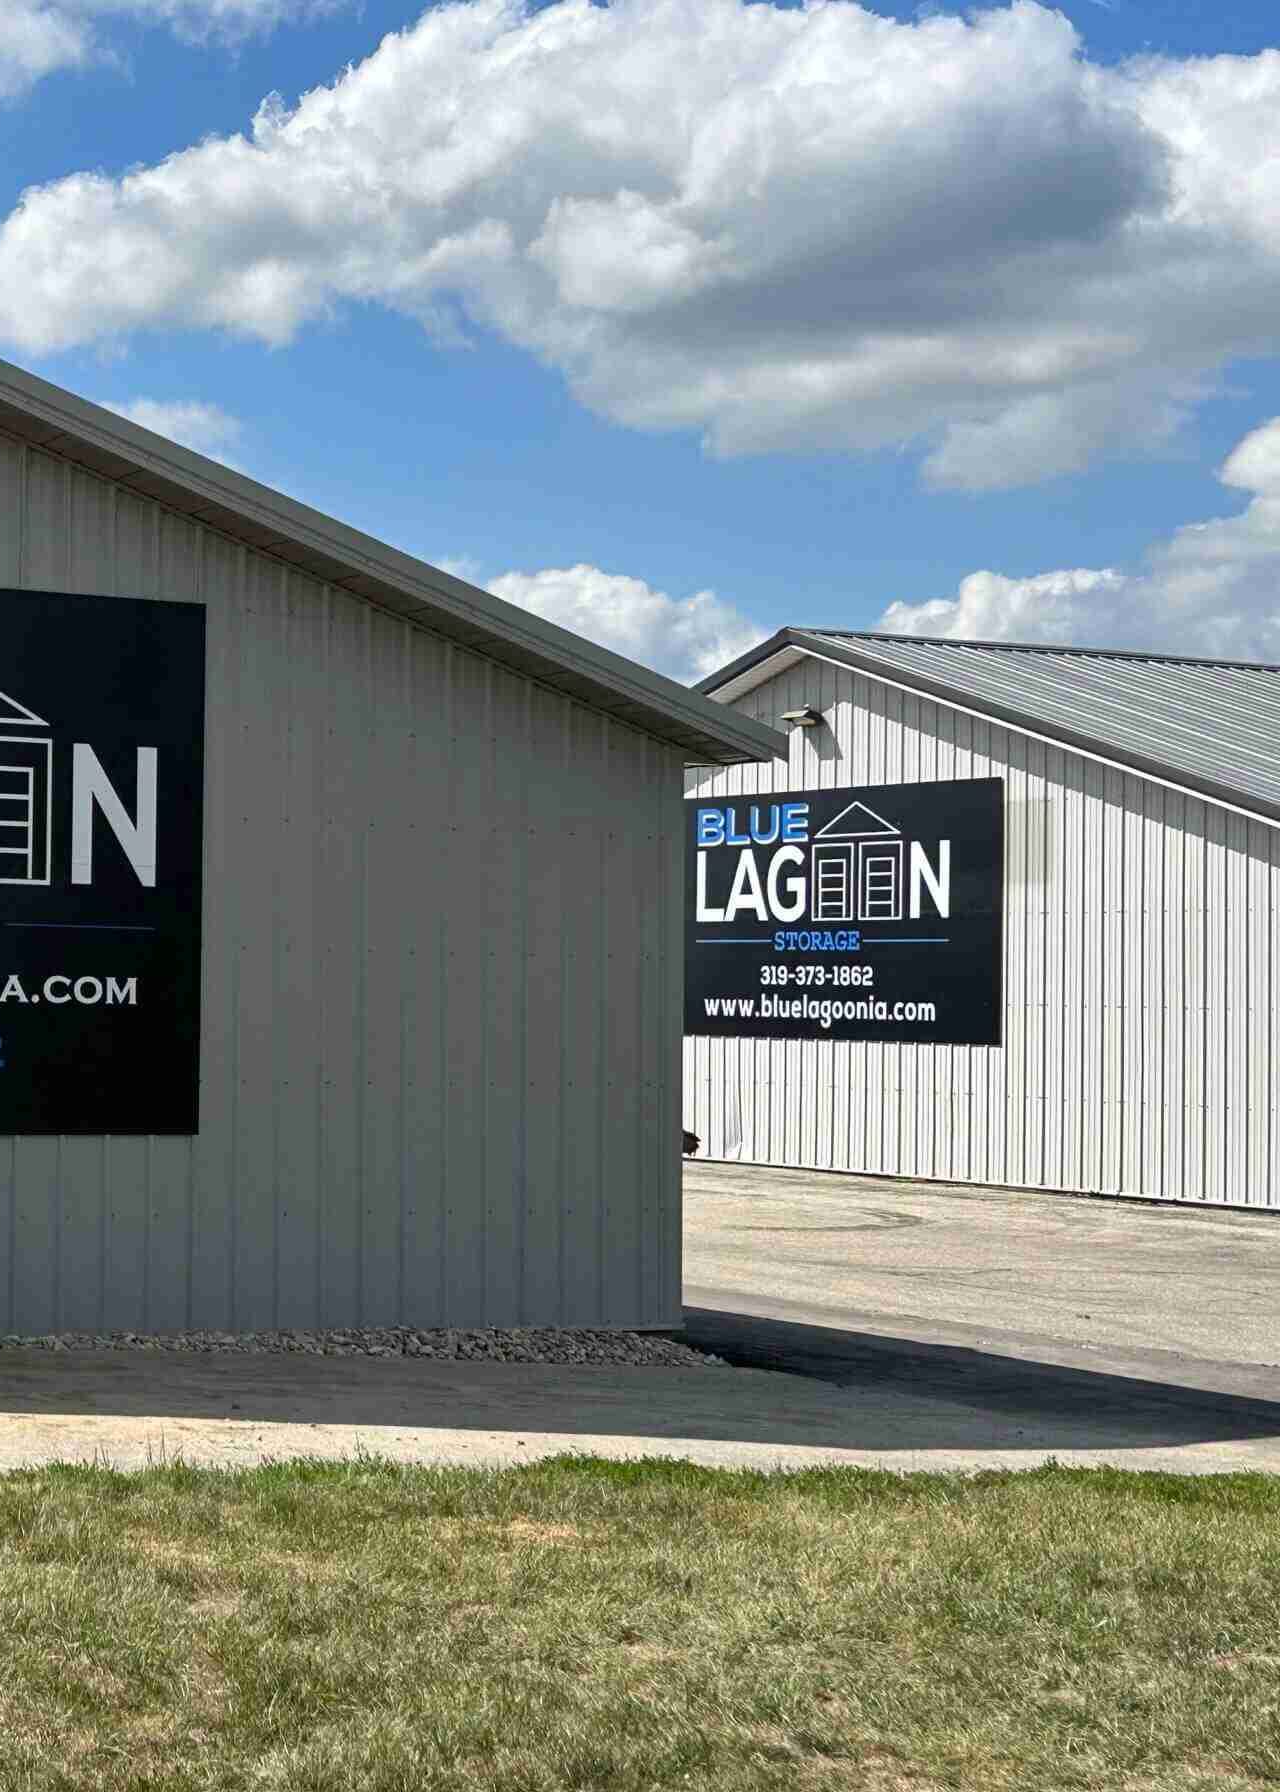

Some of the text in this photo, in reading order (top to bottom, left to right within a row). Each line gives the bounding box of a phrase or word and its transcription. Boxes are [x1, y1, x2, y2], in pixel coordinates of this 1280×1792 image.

[696, 803, 809, 847] BLUE
[774, 930, 860, 951] STORAGE
[760, 965, 873, 986] 319-373-1862
[704, 993, 936, 1029] www.bluelagoonia.com
